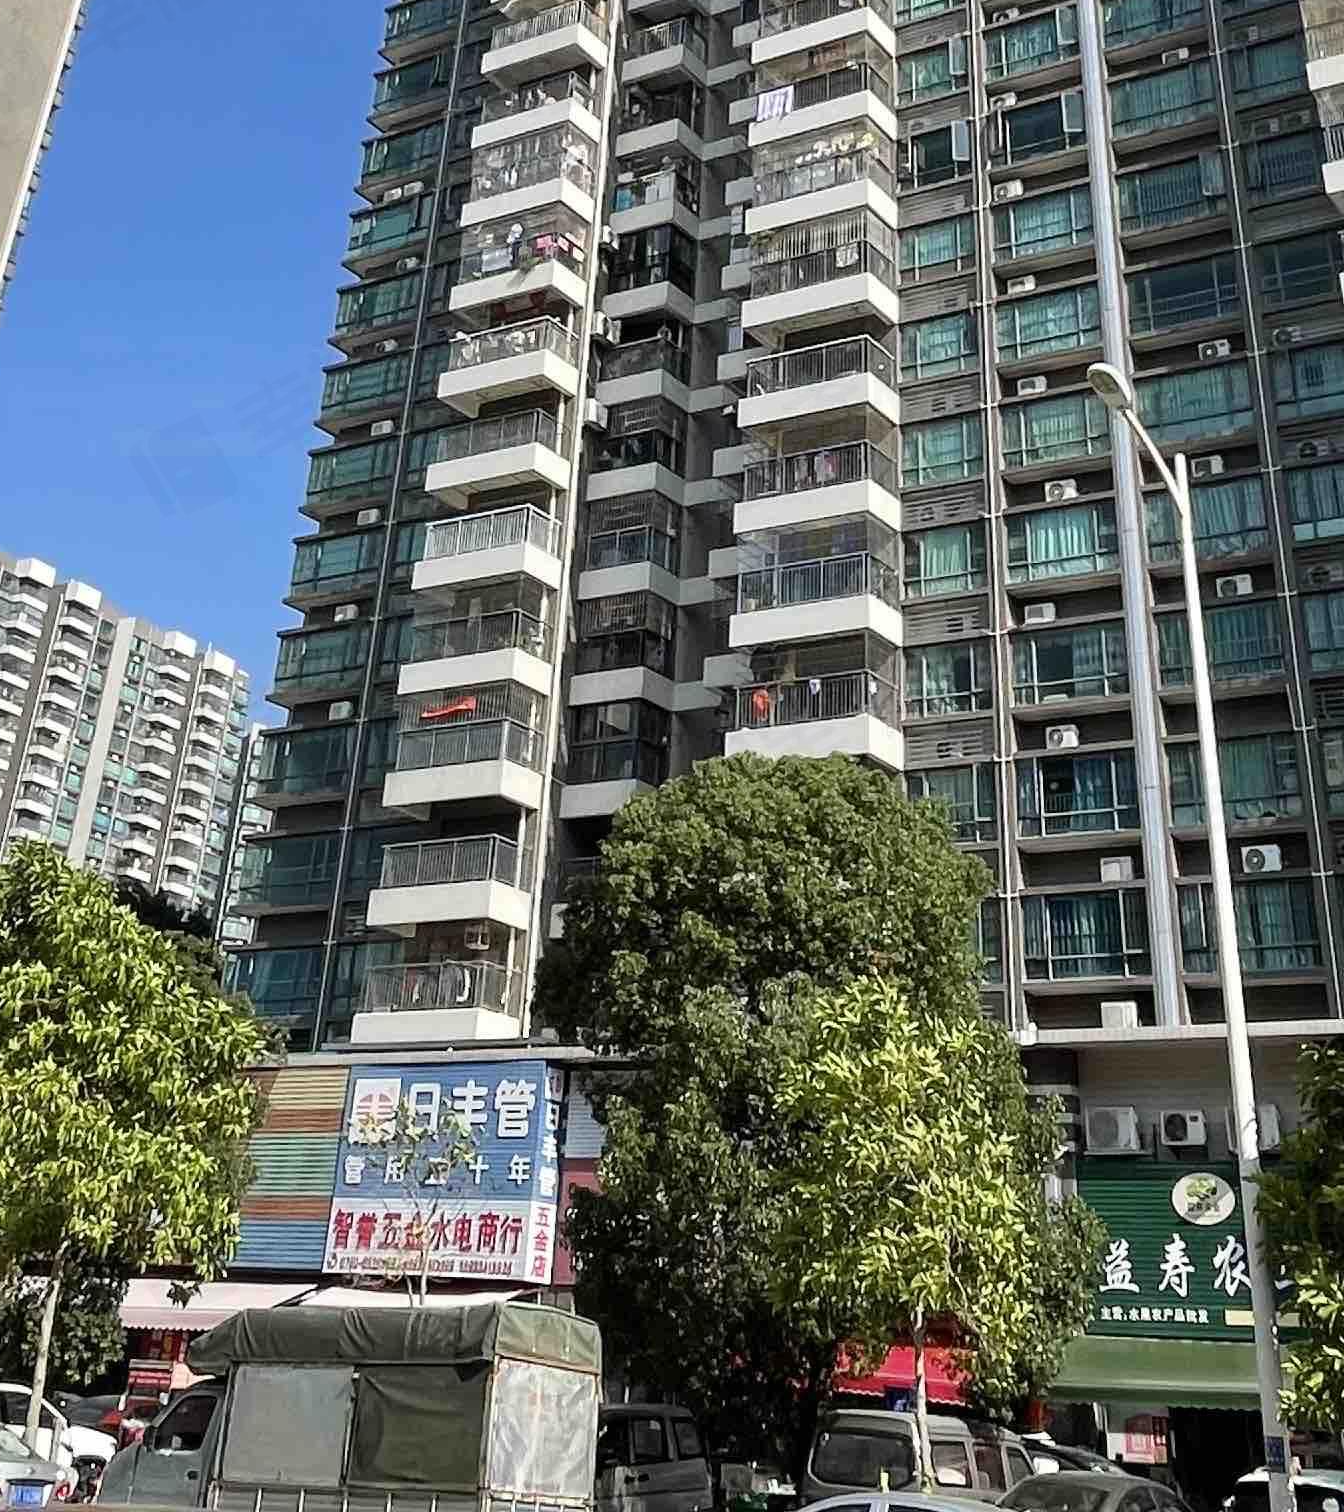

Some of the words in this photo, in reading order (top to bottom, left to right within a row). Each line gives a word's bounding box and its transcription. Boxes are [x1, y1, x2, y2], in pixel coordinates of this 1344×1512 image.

[409, 1079, 536, 1138] 日丰管
[533, 1207, 552, 1277] 五金店
[1099, 1233, 1296, 1298] 益寿农
